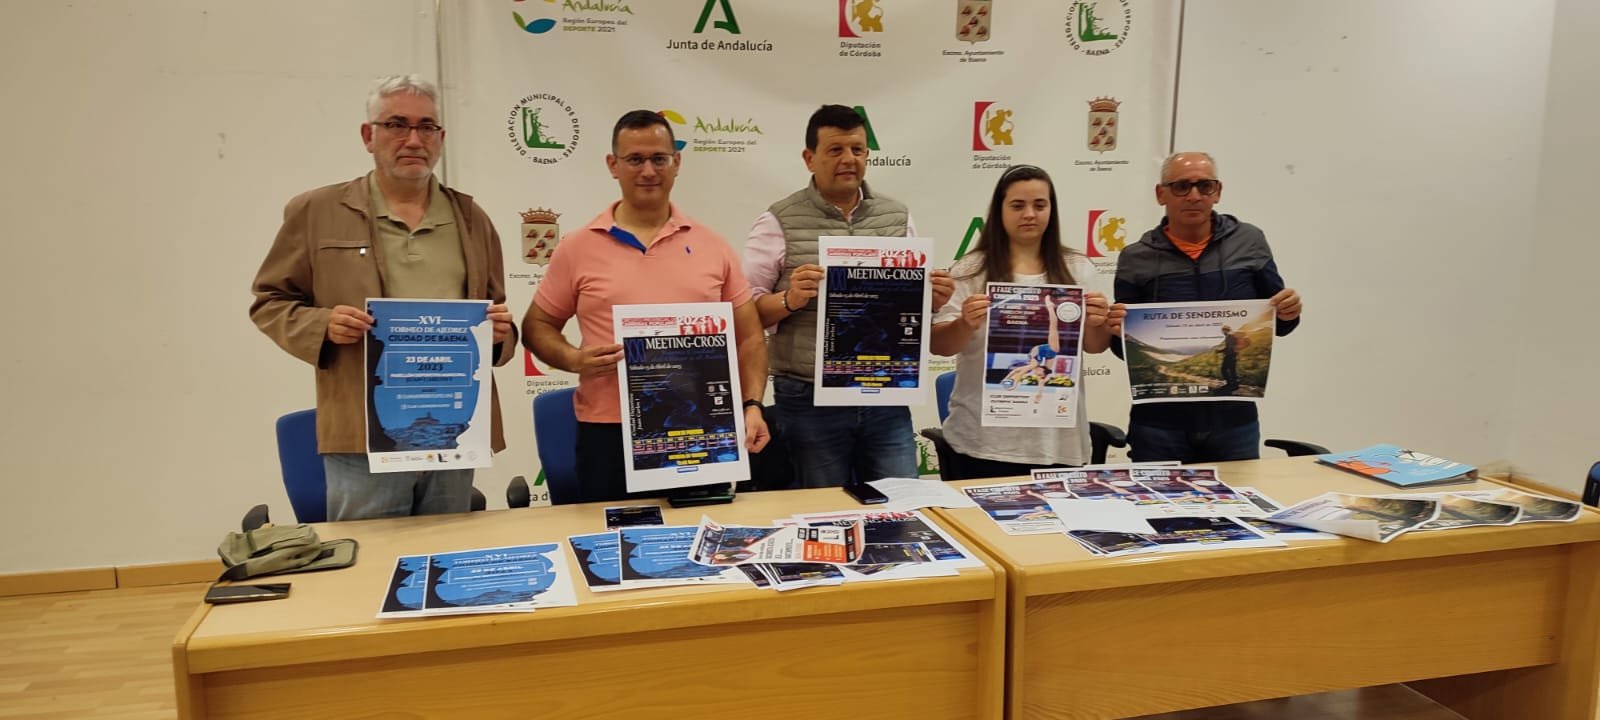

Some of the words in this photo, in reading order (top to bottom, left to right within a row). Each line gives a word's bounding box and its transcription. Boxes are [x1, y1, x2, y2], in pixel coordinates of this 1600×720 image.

[666, 39, 698, 50] Junta
[701, 40, 715, 50] de
[717, 40, 773, 52] Andalucía
[840, 41, 881, 49] Diputación
[850, 50, 882, 58] Córdoba
[520, 93, 565, 107] MUNICIPAL
[565, 105, 576, 117] DE
[694, 116, 764, 135] Andalucía
[866, 155, 911, 167] ndalucía
[973, 155, 1011, 163] Diputación
[847, 268, 923, 281] MEETING-CROSS
[1185, 310, 1248, 319] SENDERISMO
[419, 315, 441, 324] XVI
[389, 334, 423, 342] CIUDAD
[438, 334, 468, 342] BAENA
[645, 335, 726, 350] MEETING-CROSS
[526, 380, 569, 388] Diputación
